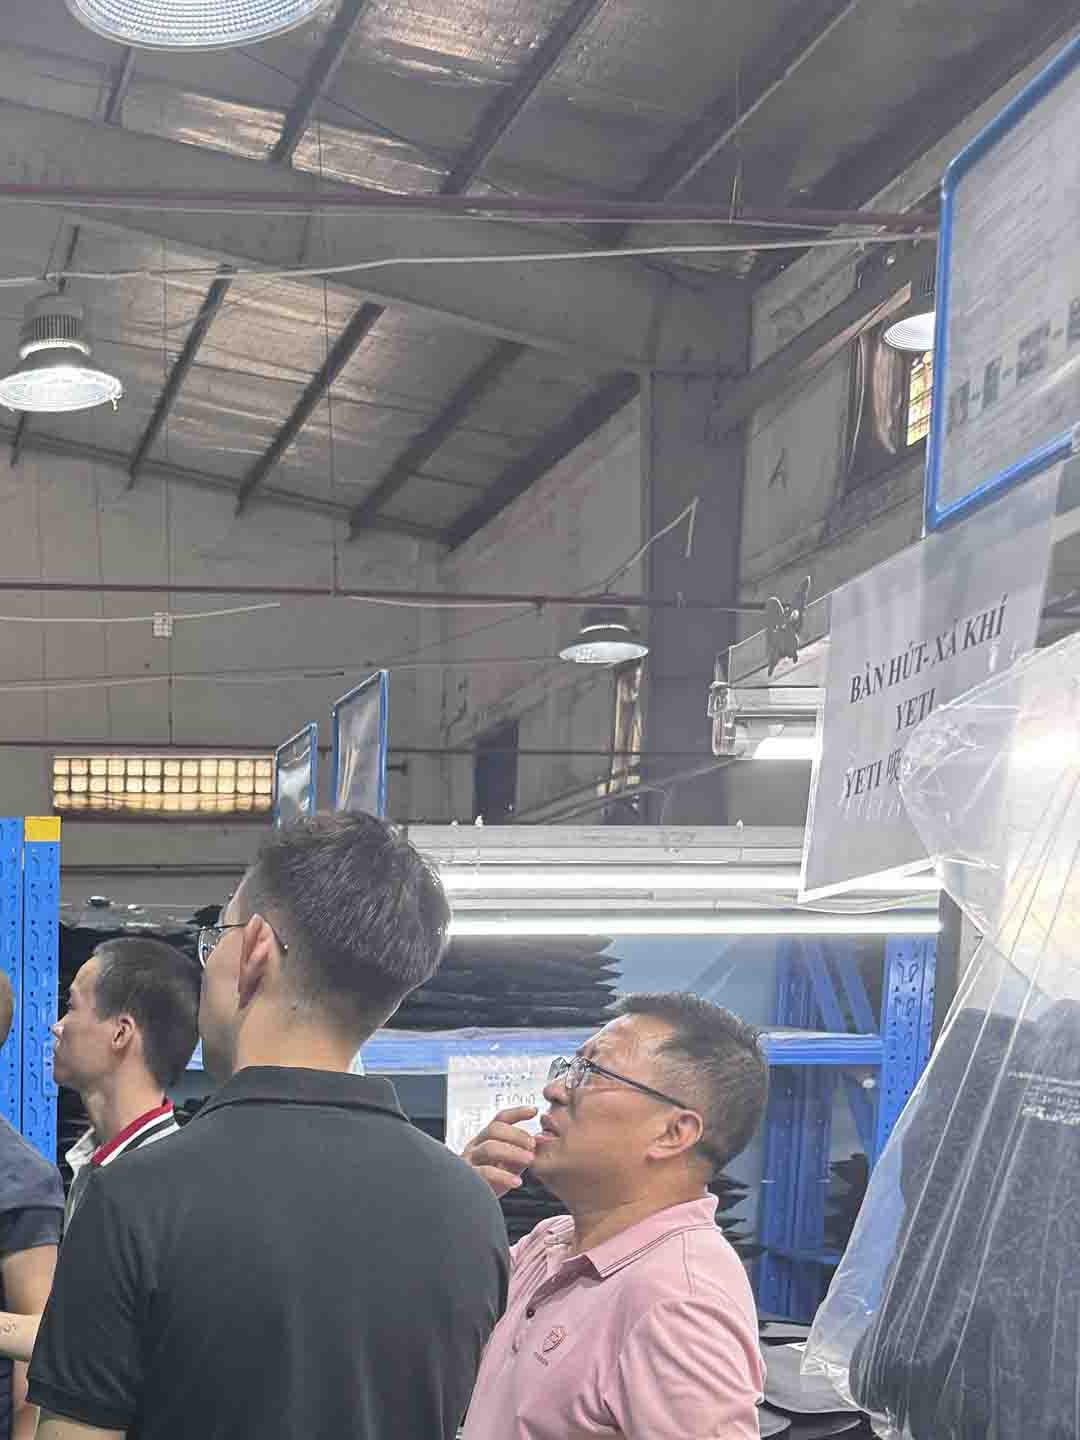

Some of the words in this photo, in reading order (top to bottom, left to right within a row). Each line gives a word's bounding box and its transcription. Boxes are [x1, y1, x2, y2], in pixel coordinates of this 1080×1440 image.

[962, 593, 1009, 651] KHÍ
[896, 687, 937, 732] YETI
[844, 759, 882, 798] YETI
